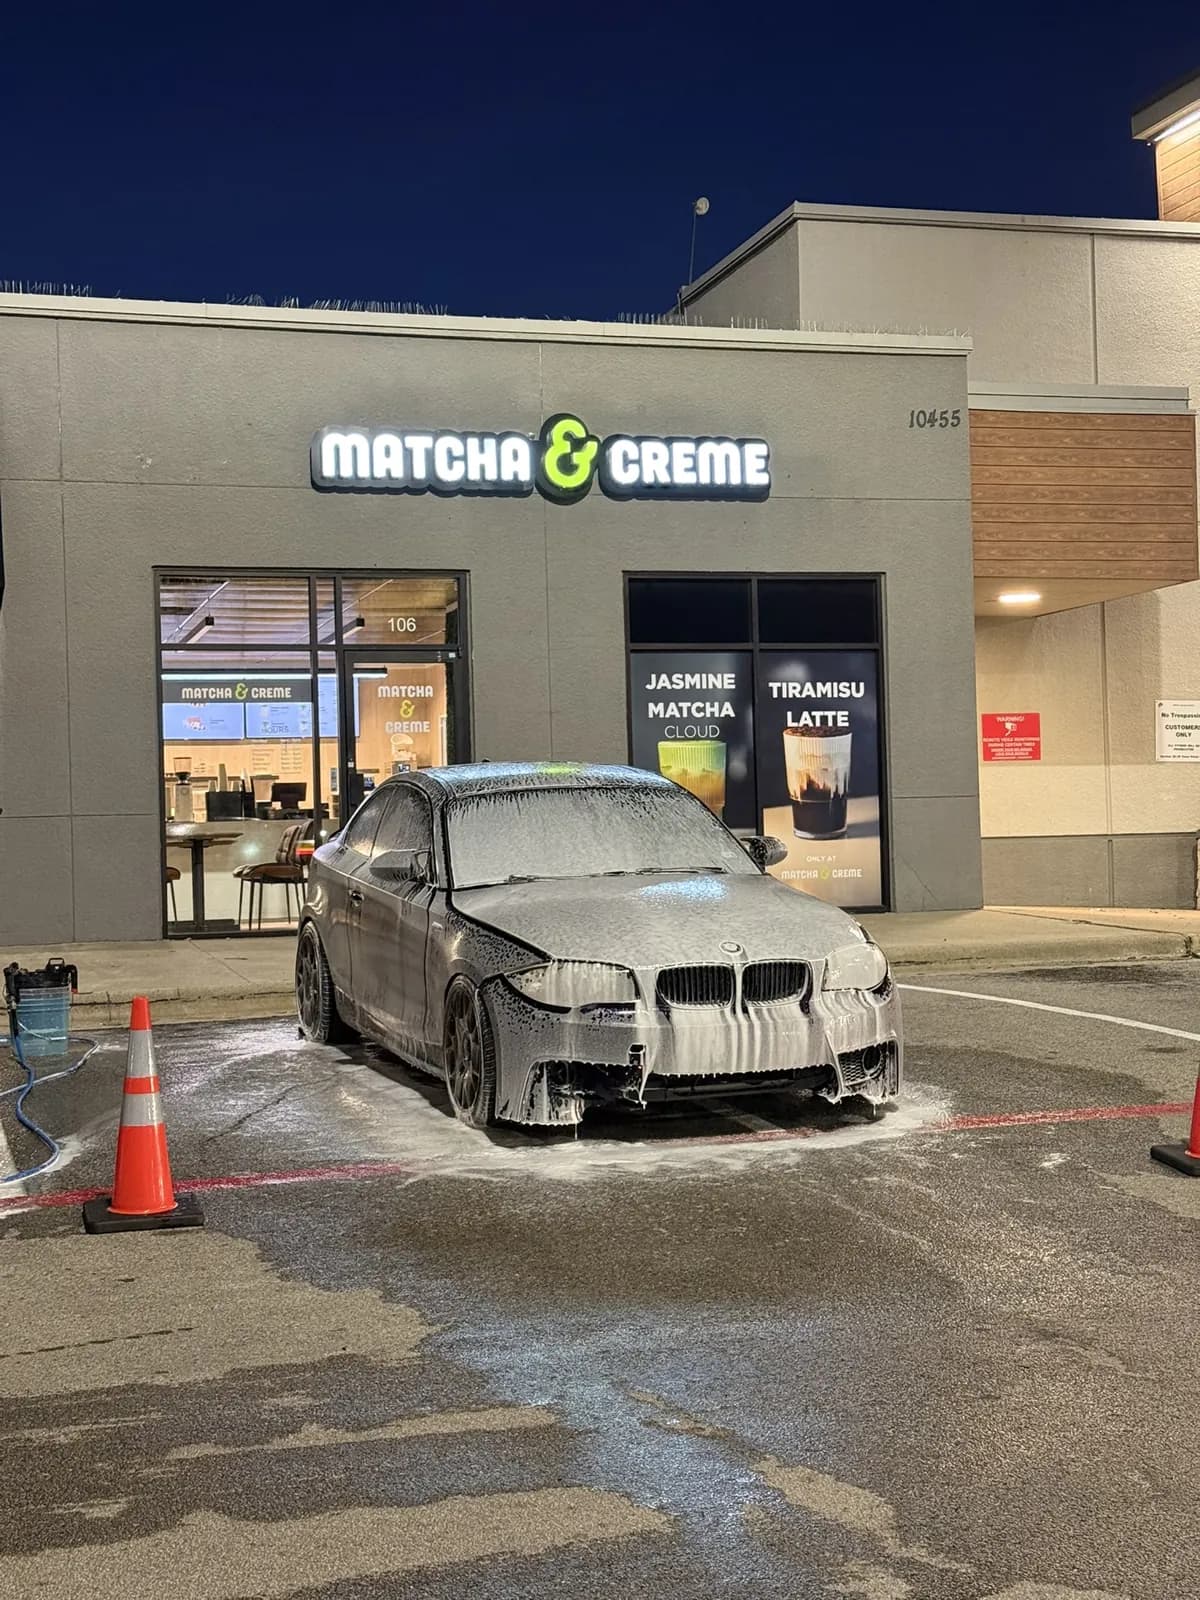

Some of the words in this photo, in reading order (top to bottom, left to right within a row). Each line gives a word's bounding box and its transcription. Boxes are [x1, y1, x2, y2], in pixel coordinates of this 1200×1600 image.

[908, 408, 961, 428] 10455
[320, 431, 531, 483] MATCHA
[544, 418, 598, 489] &
[609, 438, 770, 486] CREME
[387, 617, 417, 632] 106
[645, 673, 736, 690] JASMINE
[768, 681, 865, 698] TIRAMISU
[181, 687, 233, 699] MATCHA
[235, 683, 249, 700] &
[251, 687, 292, 699] CREME
[378, 685, 434, 698] MATCHA
[400, 699, 415, 718] &
[647, 701, 736, 719] MATCHA
[786, 710, 850, 727] LATTE
[384, 721, 431, 734] CREME
[664, 724, 721, 739] CLOUD
[781, 869, 819, 880] MATCHA
[832, 868, 863, 879] CREME
